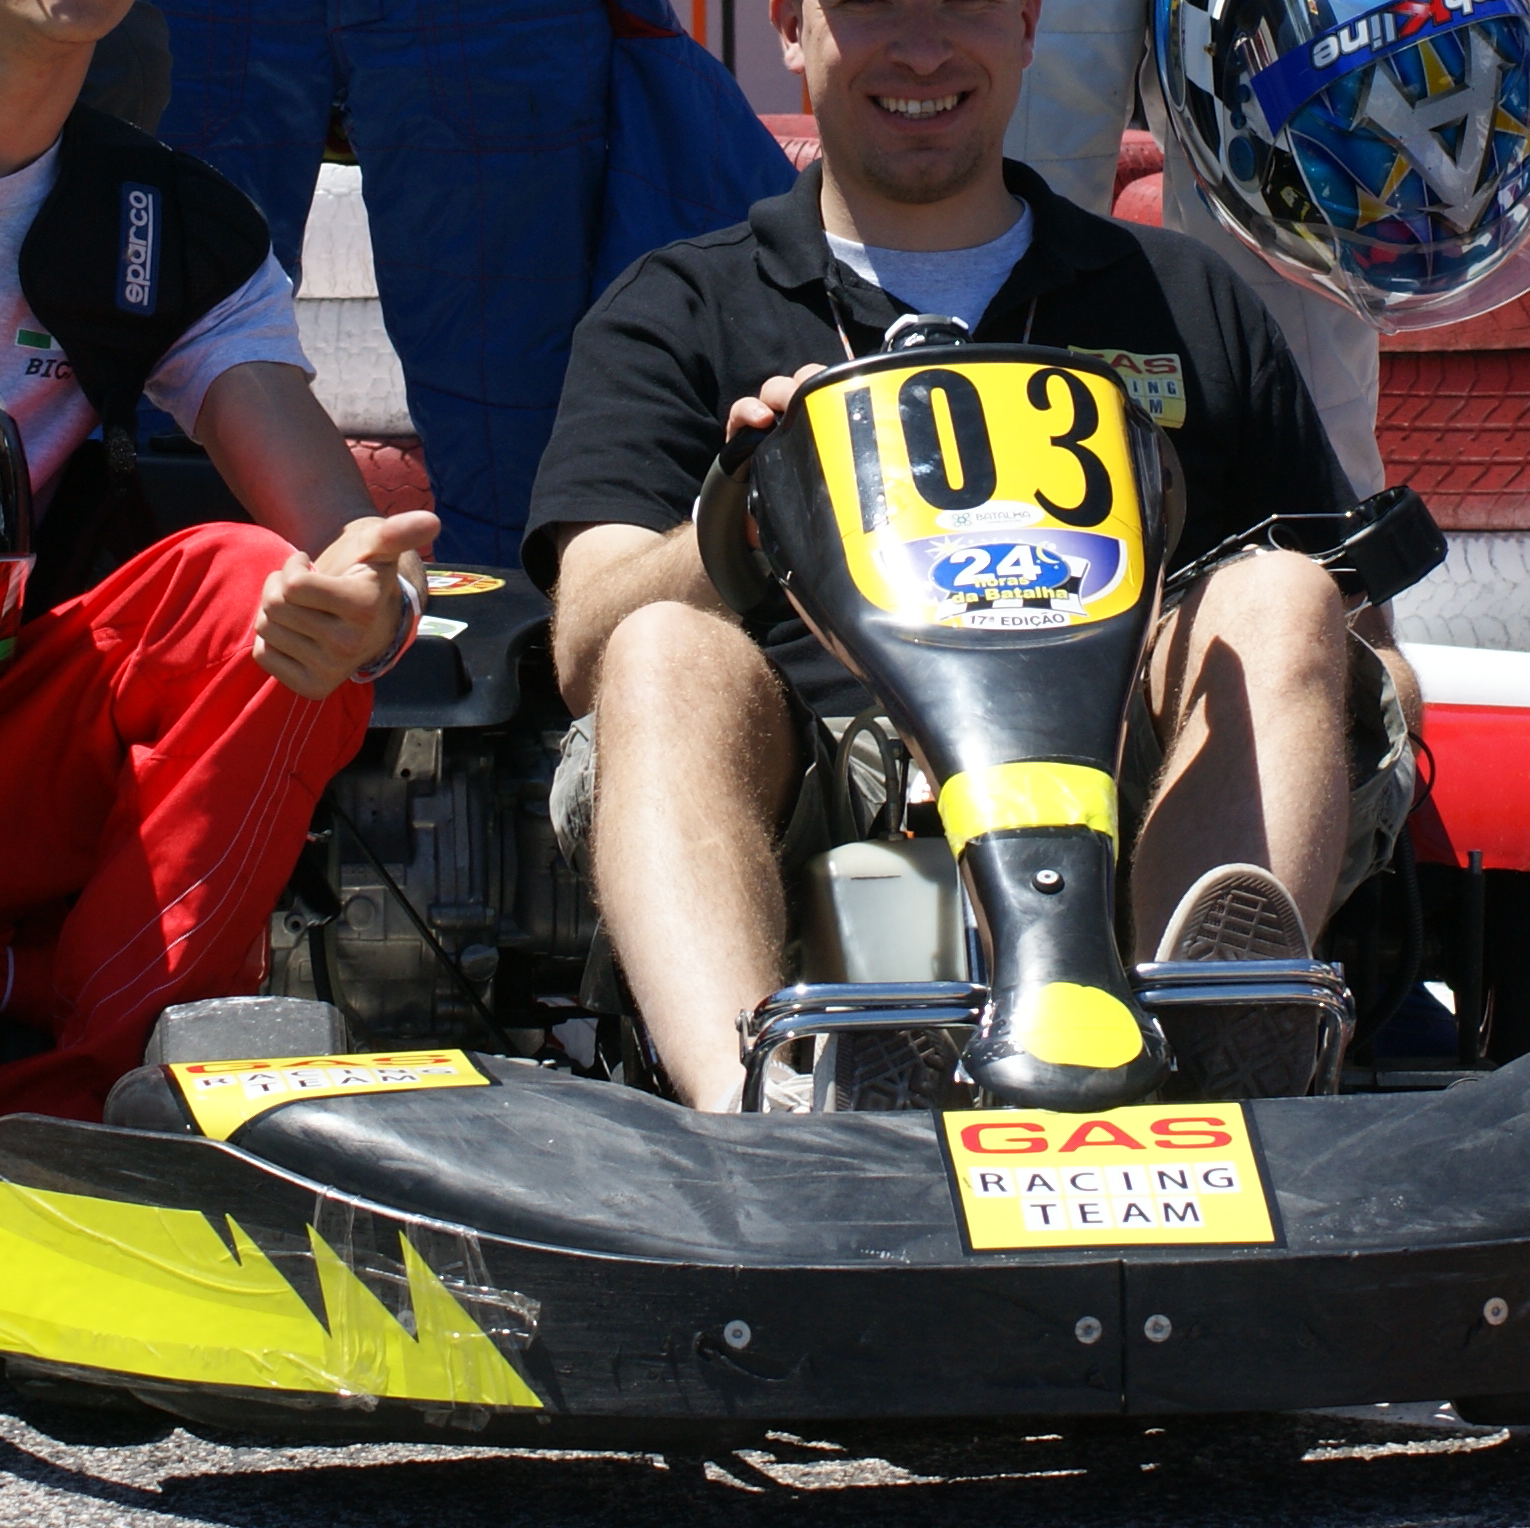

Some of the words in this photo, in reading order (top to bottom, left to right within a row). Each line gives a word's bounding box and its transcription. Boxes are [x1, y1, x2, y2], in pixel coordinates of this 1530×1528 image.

[125, 190, 150, 305] sparco
[1091, 352, 1178, 375] AS
[1132, 379, 1177, 395] ING
[844, 366, 1114, 535] 103
[949, 545, 1042, 588] 24
[973, 573, 1030, 589] horas
[952, 587, 983, 604] da
[985, 585, 1069, 602] Batalha
[1000, 611, 1066, 628] EDIÇÃO
[186, 1054, 452, 1074] GAS
[203, 1067, 452, 1087] RACING
[250, 1074, 418, 1092] TEAM
[960, 1117, 1233, 1154] GAS
[979, 1167, 1235, 1193] RACING
[1029, 1201, 1200, 1225] TEAM
